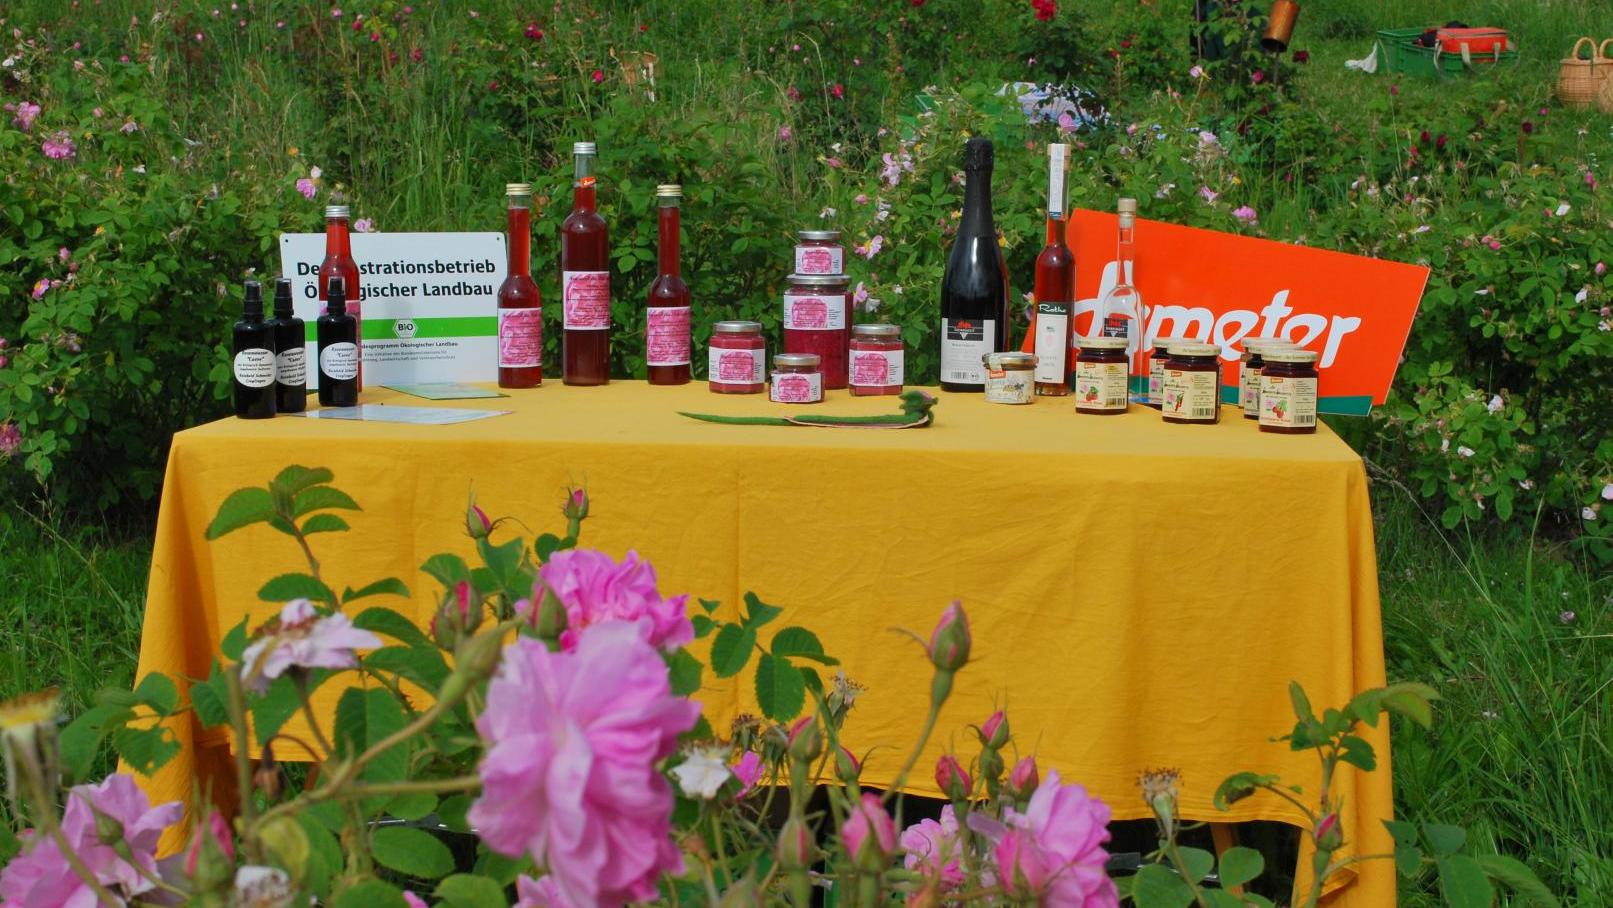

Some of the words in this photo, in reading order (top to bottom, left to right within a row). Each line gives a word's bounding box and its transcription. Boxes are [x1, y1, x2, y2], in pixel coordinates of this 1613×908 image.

[297, 259, 496, 276] Destrationsbetrieb
[304, 281, 417, 301] Ögischer
[423, 282, 493, 297] Landbau
[1073, 260, 1362, 374] dmeter
